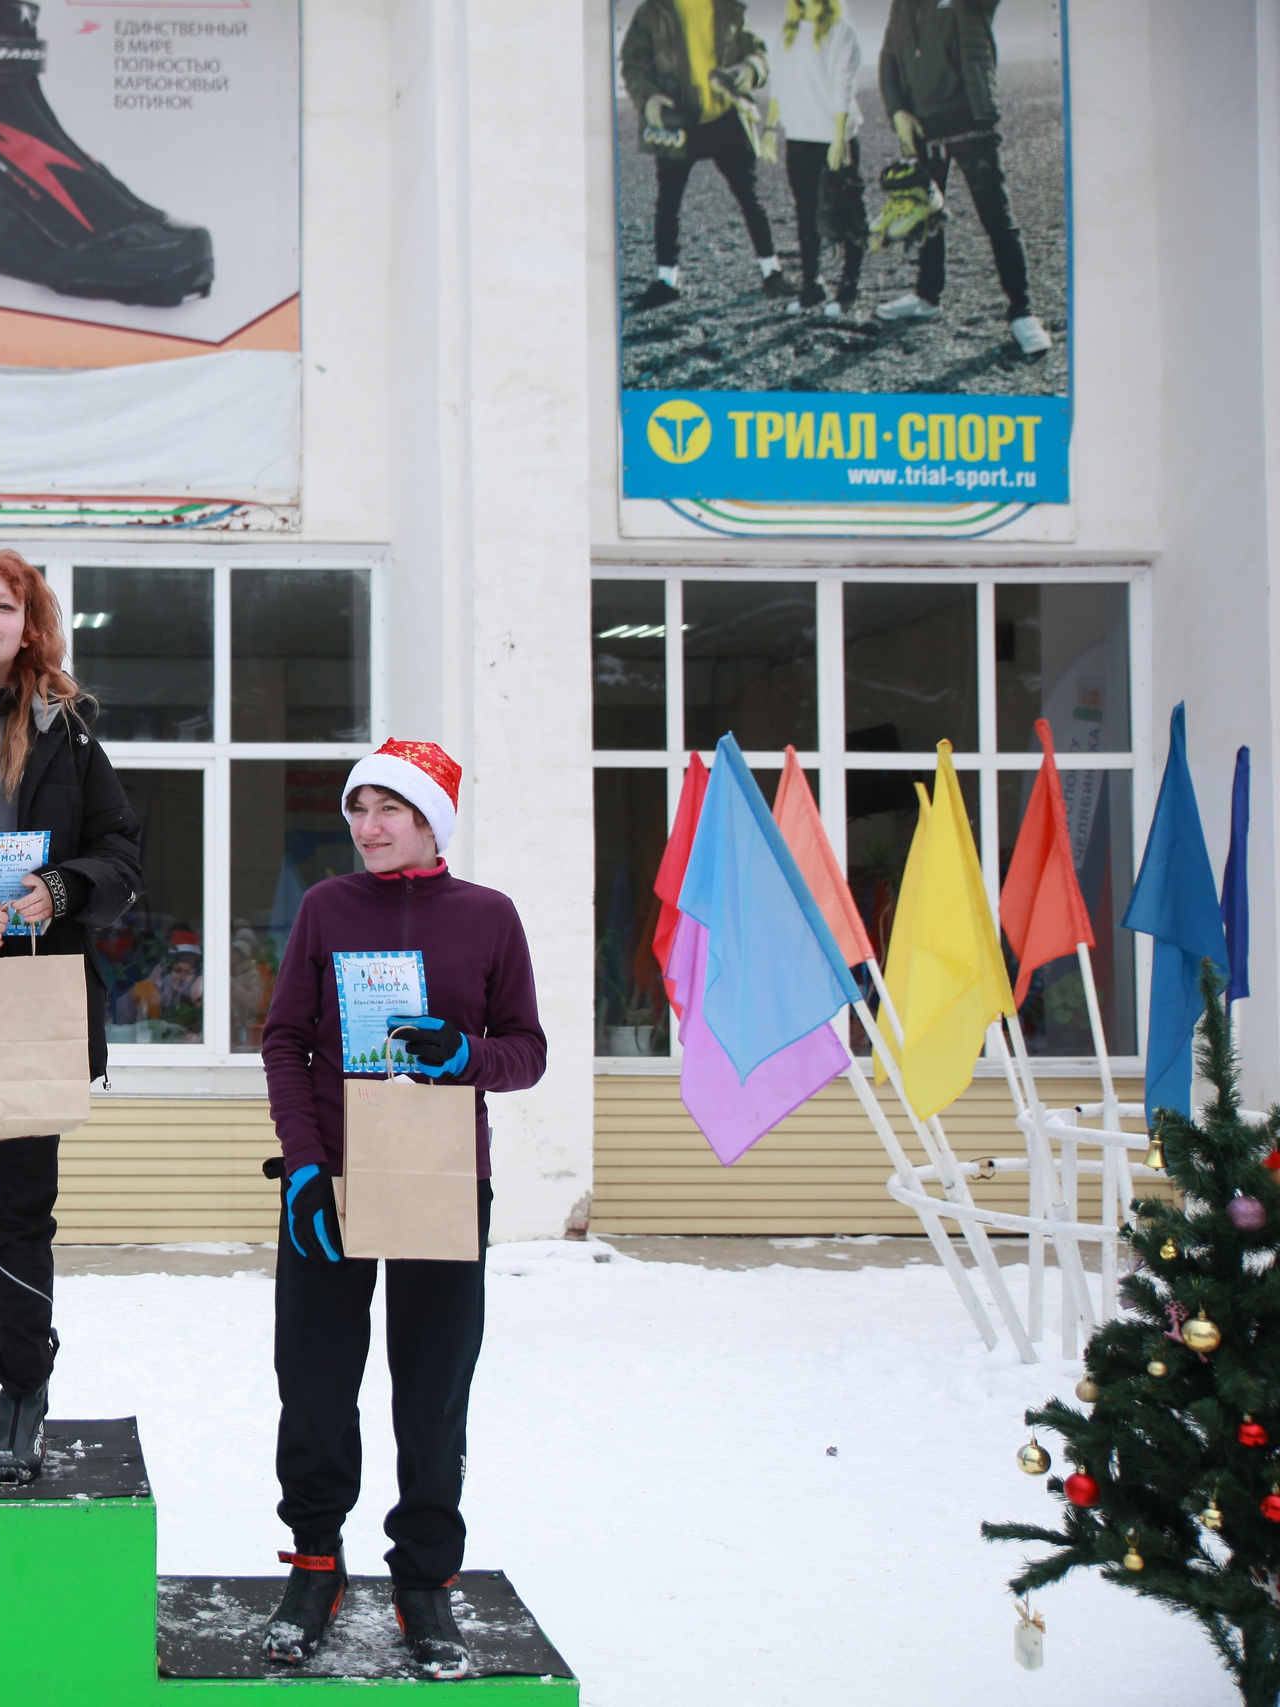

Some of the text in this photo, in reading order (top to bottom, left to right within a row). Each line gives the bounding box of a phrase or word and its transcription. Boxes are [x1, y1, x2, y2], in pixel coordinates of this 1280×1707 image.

[114, 18, 247, 37] ЕДИНСТВЕННЫЙ
[114, 39, 173, 55] В МИРЕ
[114, 57, 221, 74] ПОЛНОСТЬЮ
[114, 75, 229, 92] КАРБОНОВЫЙ
[114, 94, 193, 110] БОТИНОК
[847, 464, 1036, 490] www.trial-sport.ru
[1074, 727, 1101, 860] ЧЕЛЯБИНКА
[353, 982, 410, 992] ГРАМОТА
